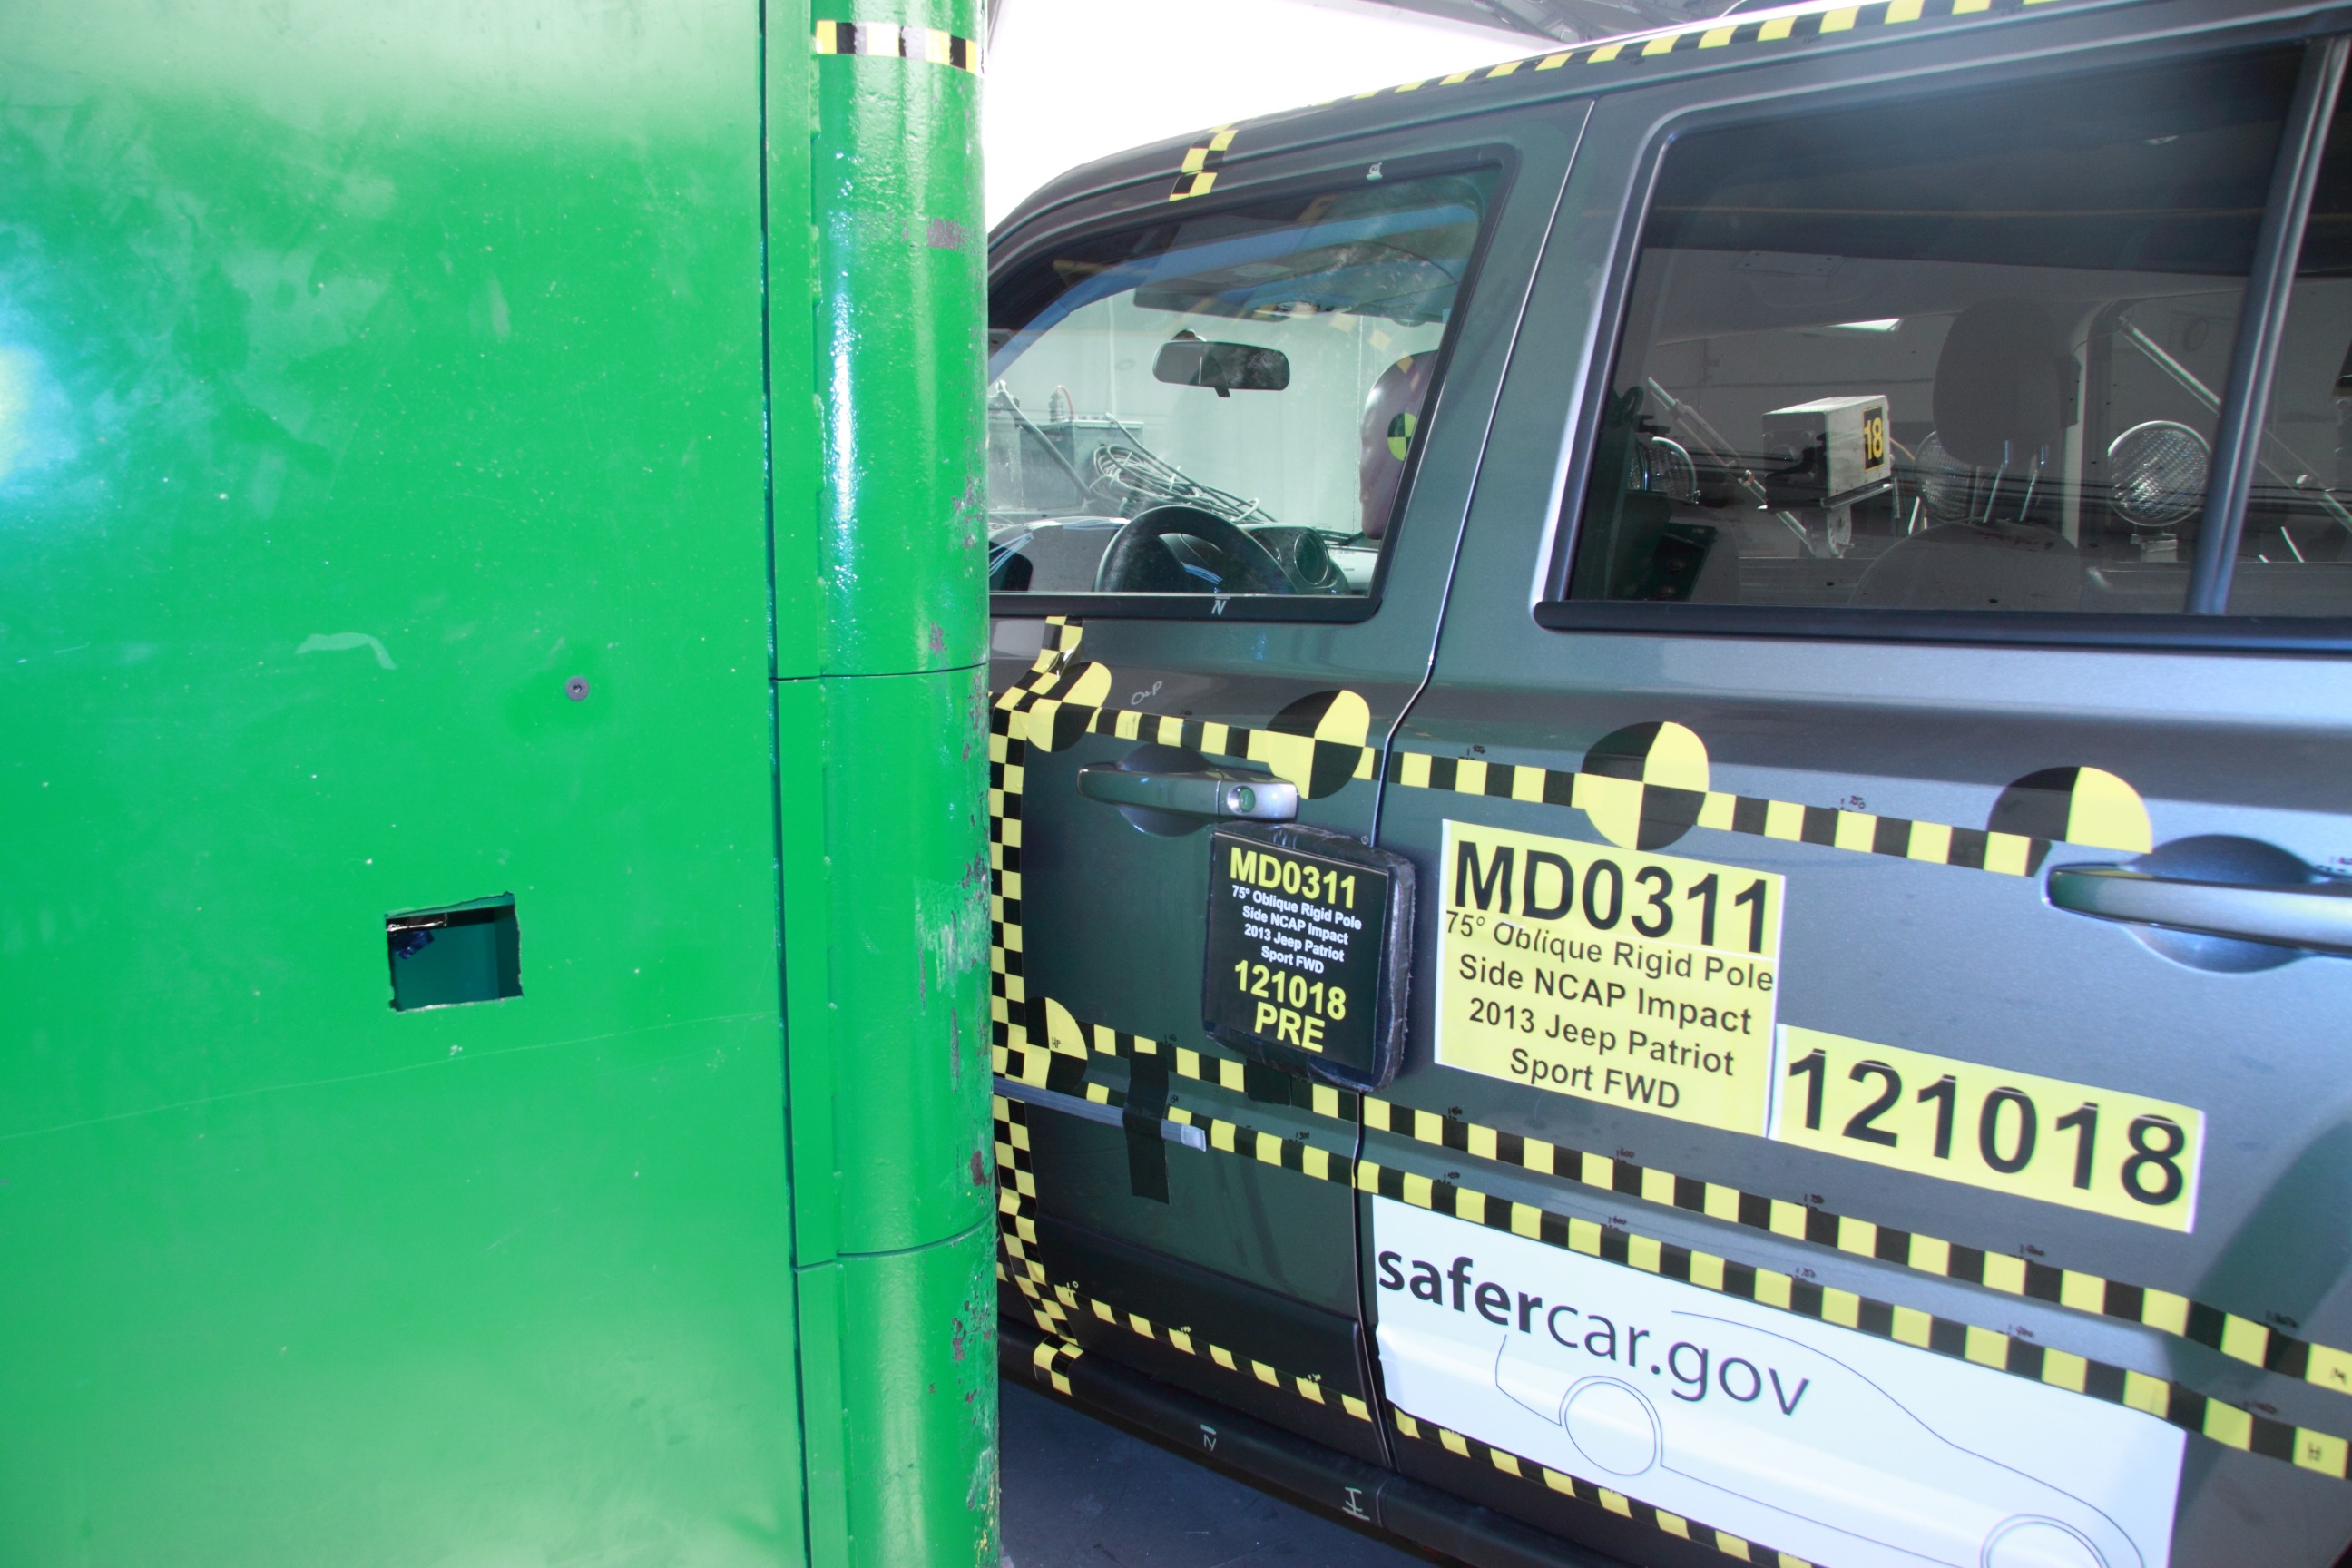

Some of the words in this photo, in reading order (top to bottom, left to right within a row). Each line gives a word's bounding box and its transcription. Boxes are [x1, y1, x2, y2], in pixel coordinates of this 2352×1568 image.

[1863, 416, 1884, 460] 18
[1230, 846, 1356, 909] MD0311
[1455, 838, 1768, 955] MD0311
[1242, 905, 1269, 923] Side
[1270, 912, 1306, 932] NCAP
[1308, 920, 1348, 946] Impact
[1252, 890, 1298, 914] Oblique
[1300, 902, 1332, 925] Rigid
[1335, 910, 1362, 930] Pole
[1244, 923, 1271, 942] 2013
[1273, 931, 1302, 952] Jeep
[1305, 940, 1345, 962] Patriot
[1260, 946, 1294, 965] Sport
[1296, 955, 1325, 974] FWD
[1493, 920, 1602, 963] Oblique
[1613, 940, 1693, 980] Rigid
[1704, 956, 1774, 992] Pole
[1234, 959, 1347, 1021] 121018
[1458, 953, 1524, 990] Side
[1534, 967, 1627, 1009] NCAP
[1638, 987, 1752, 1035] Impact
[1254, 1000, 1326, 1054] PRE
[1469, 997, 1535, 1034] 2013
[1544, 1014, 1617, 1056] Jeep
[1628, 1029, 1735, 1076] Patriot
[1510, 1047, 1593, 1092] Sport
[1603, 1067, 1681, 1110] FWD
[1788, 1047, 2188, 1207] 121018
[1377, 1248, 1810, 1417] safercar.gov
